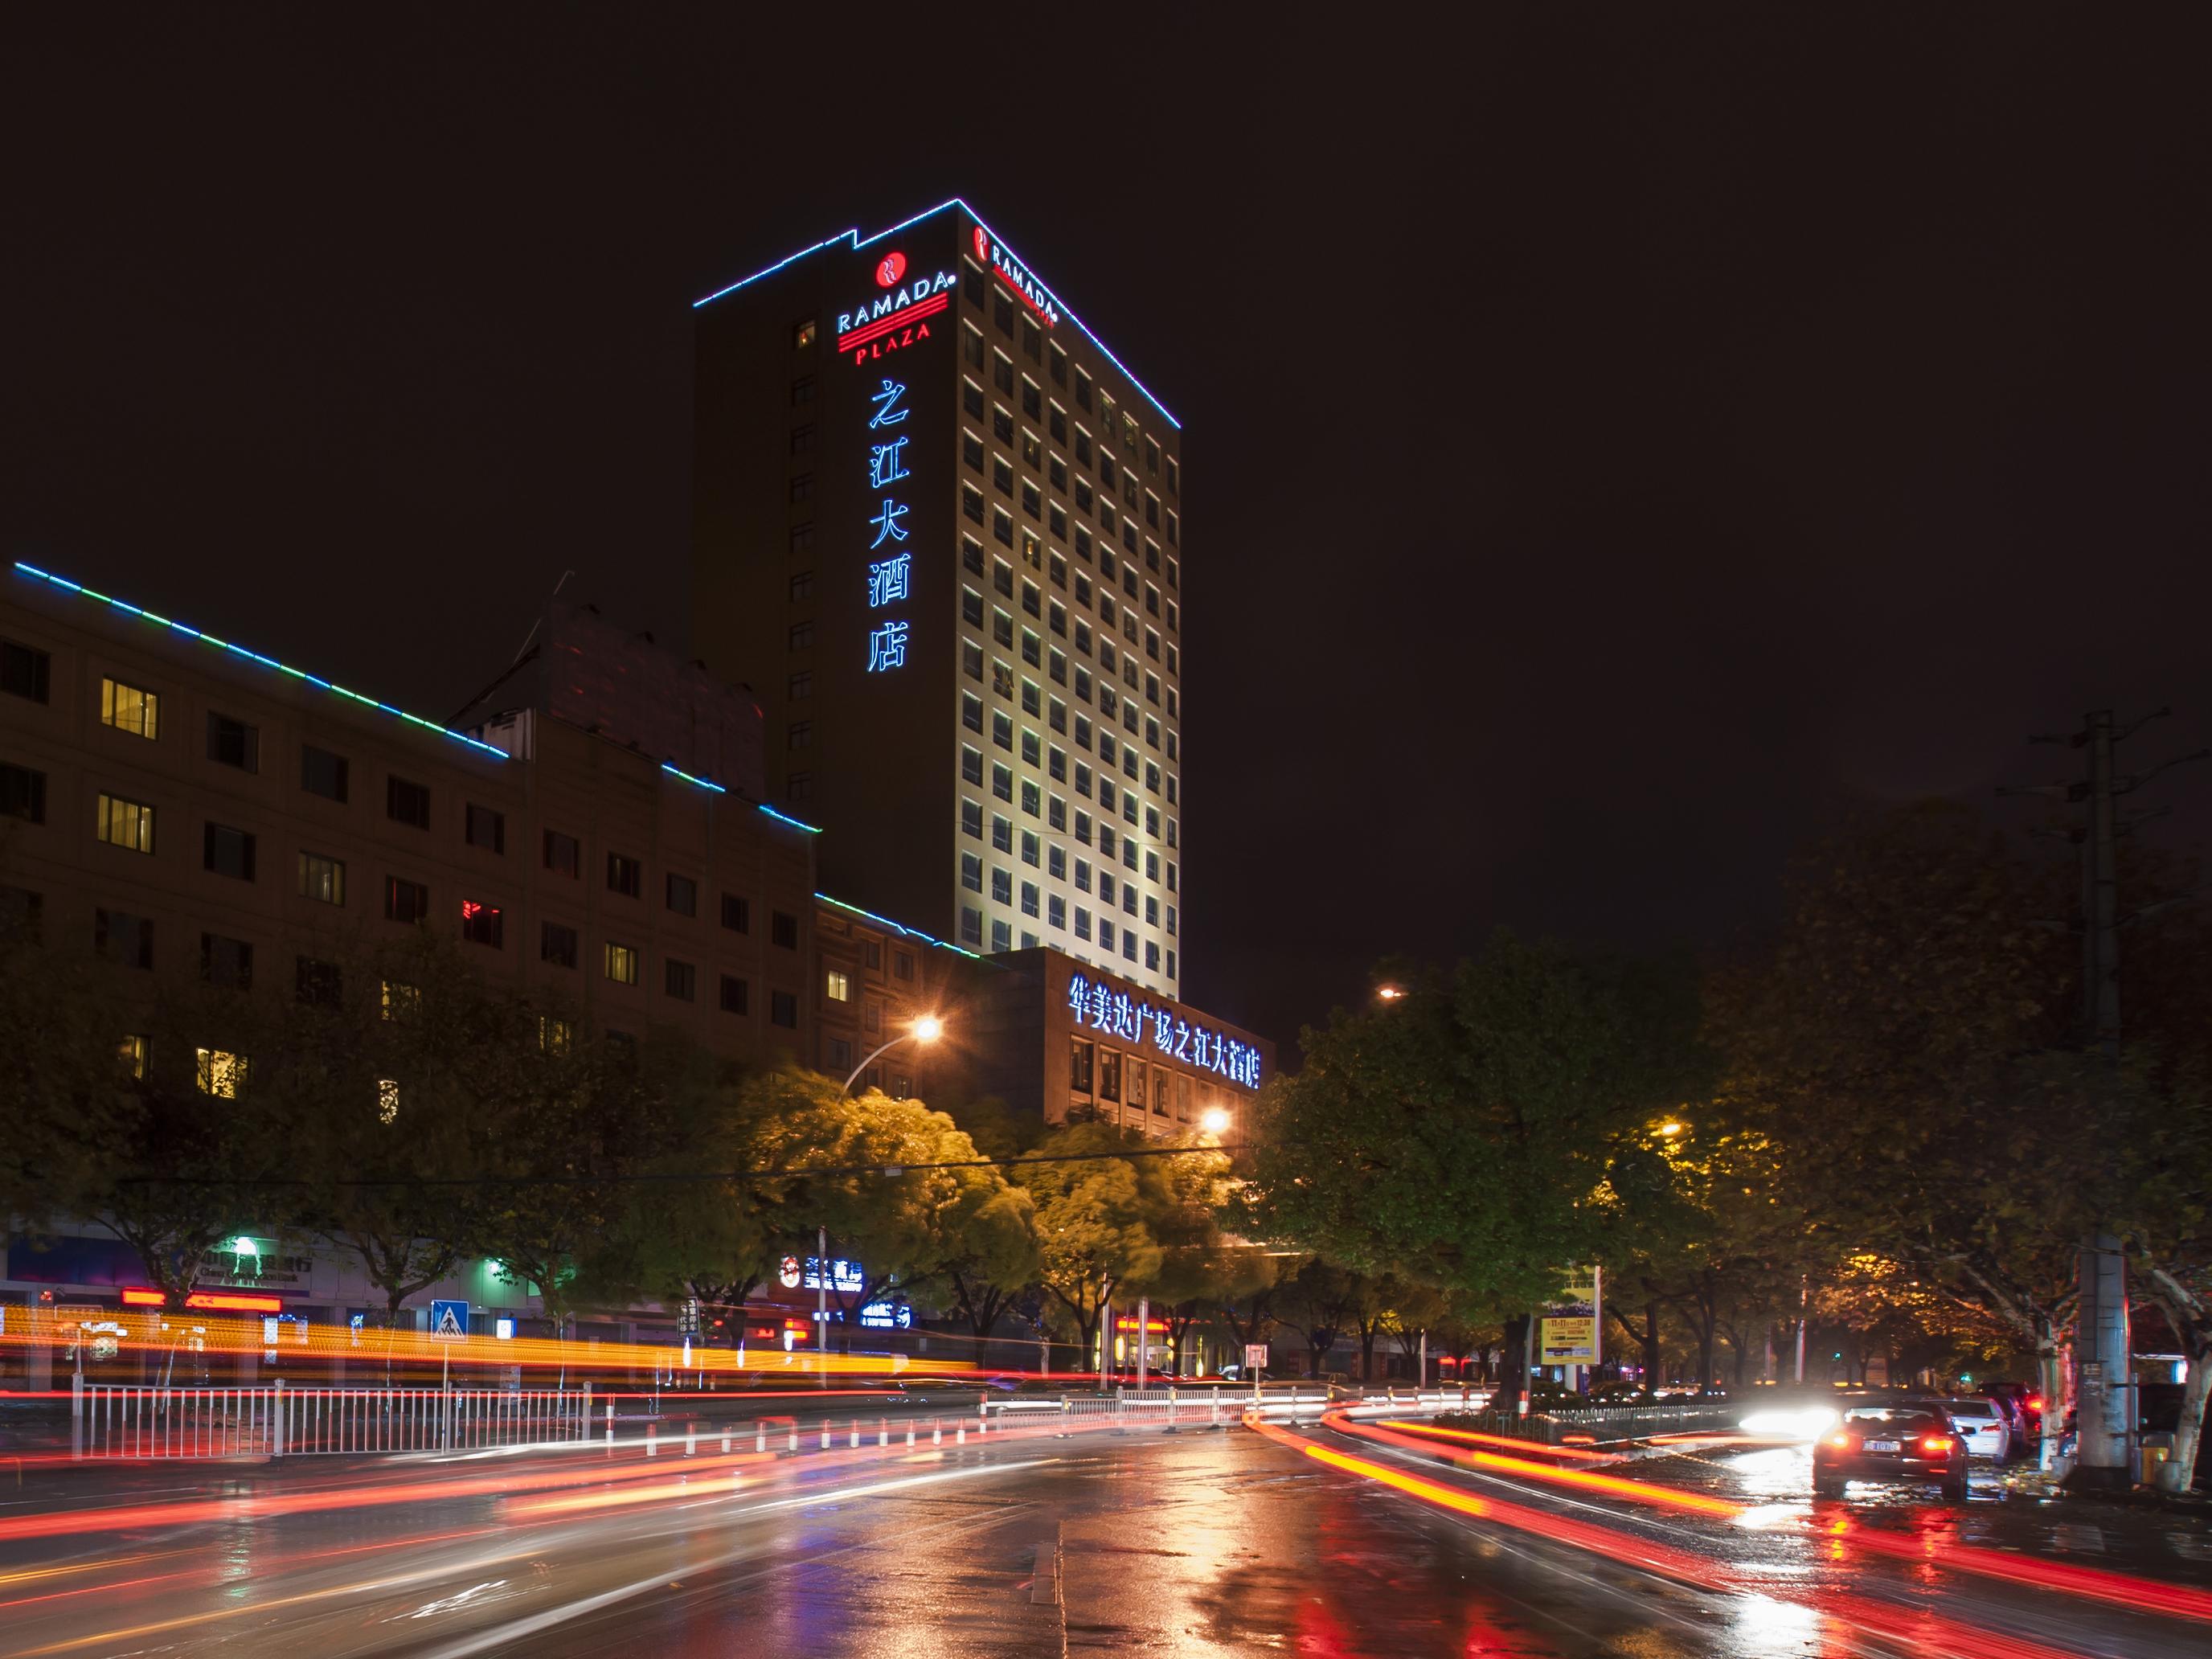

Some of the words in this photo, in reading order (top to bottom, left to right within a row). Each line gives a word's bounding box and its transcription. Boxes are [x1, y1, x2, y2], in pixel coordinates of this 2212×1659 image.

[837, 271, 948, 334] RAMADA
[992, 244, 1055, 319] RAMADA
[855, 323, 931, 366] PLAZA
[867, 379, 911, 673] 之江大酒店
[1067, 974, 1261, 1090] 华美达广场之江大酒店
